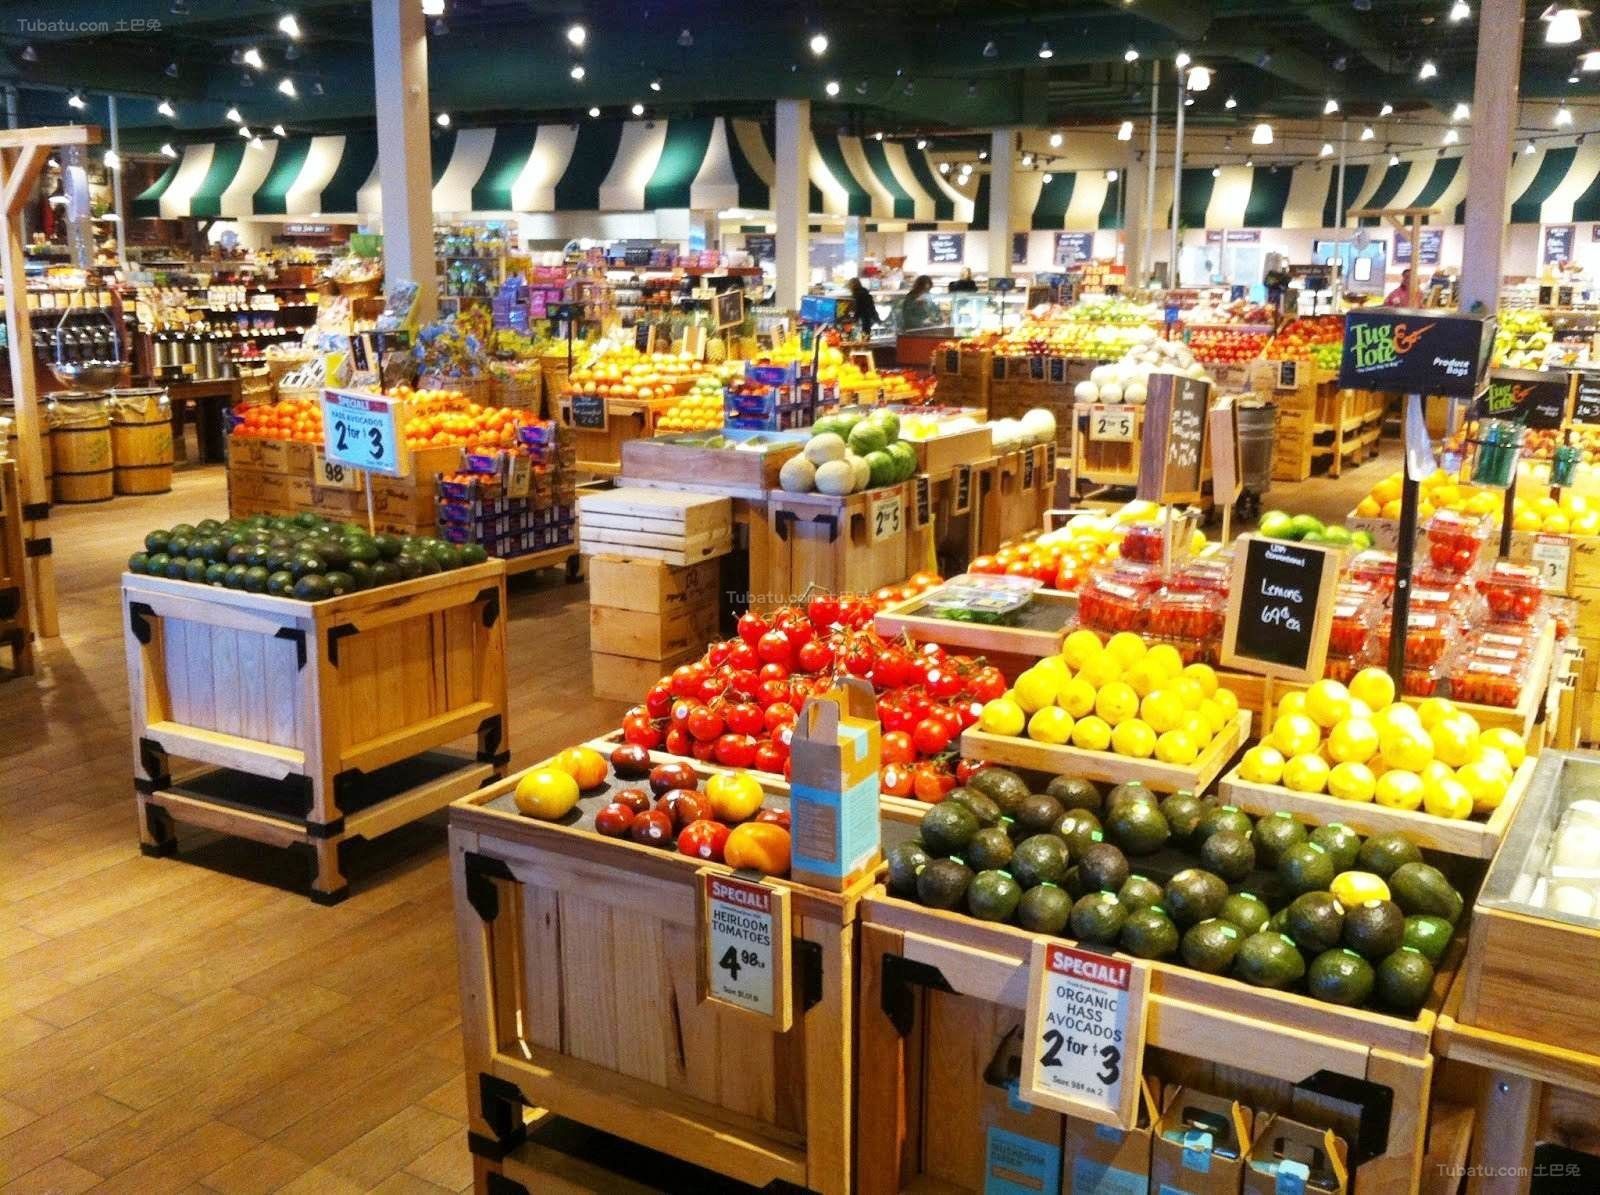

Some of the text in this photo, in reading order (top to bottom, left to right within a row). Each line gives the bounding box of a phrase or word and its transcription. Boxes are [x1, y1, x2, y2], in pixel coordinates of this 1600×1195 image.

[1350, 323, 1392, 350] Tug
[1351, 339, 1399, 368] Tote
[1433, 356, 1470, 370] Produce
[1446, 366, 1469, 377] Bags
[335, 420, 349, 451] 2
[348, 425, 360, 440] for
[1098, 419, 1106, 434] 2
[1120, 419, 1130, 436] 5
[324, 461, 345, 482] 98
[875, 510, 883, 537] 2
[892, 506, 899, 532] 5
[1261, 577, 1303, 604] Lemons
[712, 881, 769, 910] SPECIAL!
[711, 919, 771, 947] TOMATOES
[713, 909, 769, 934] HEIRLOOM
[1053, 951, 1128, 985] SPECIAL!
[1056, 985, 1119, 1012] ORGANIC
[1066, 1003, 1104, 1023] HASS
[1045, 1011, 1123, 1043] AVOCADOS
[1039, 1028, 1065, 1068] 2
[1066, 1036, 1089, 1057] for
